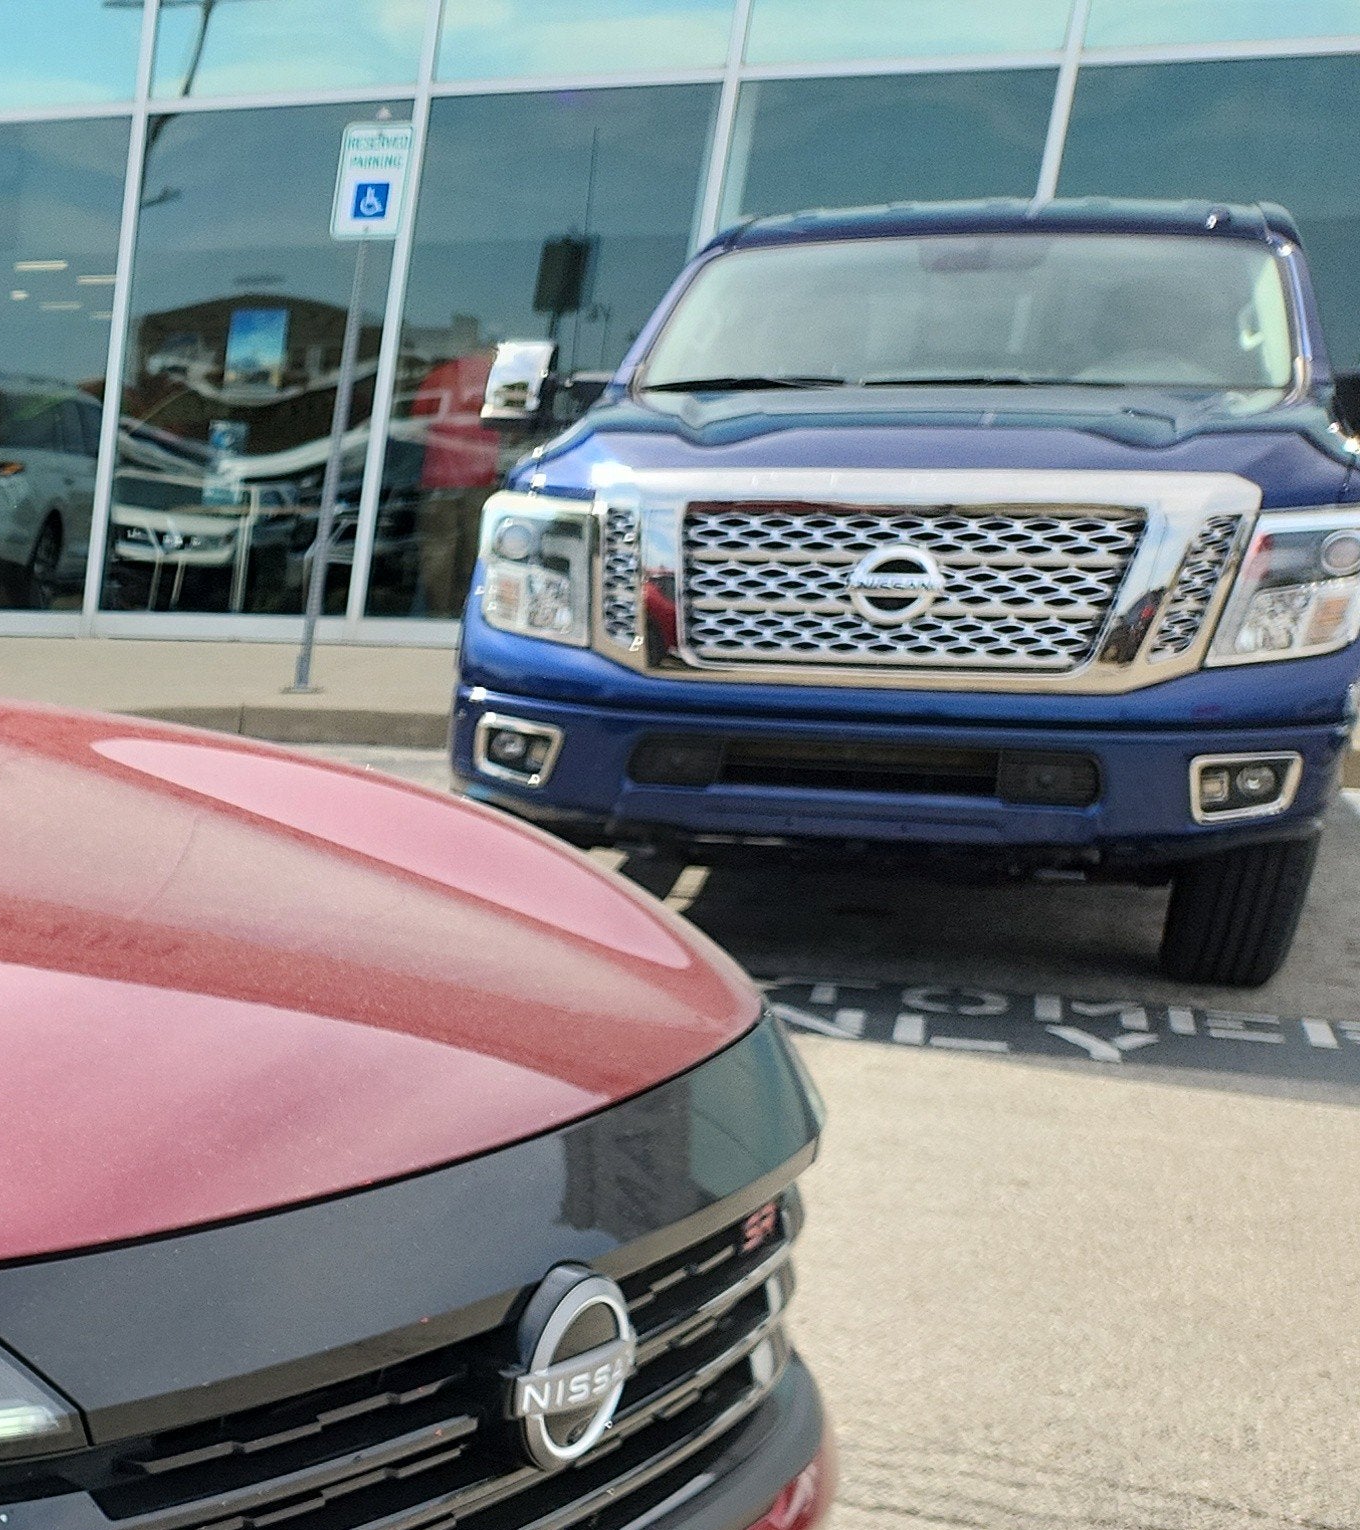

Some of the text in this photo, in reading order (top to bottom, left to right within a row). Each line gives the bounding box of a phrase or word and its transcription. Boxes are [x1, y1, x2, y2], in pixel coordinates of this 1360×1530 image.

[346, 135, 411, 151] RESERVED
[350, 154, 402, 169] PARKING
[522, 1358, 624, 1413] NISSA
